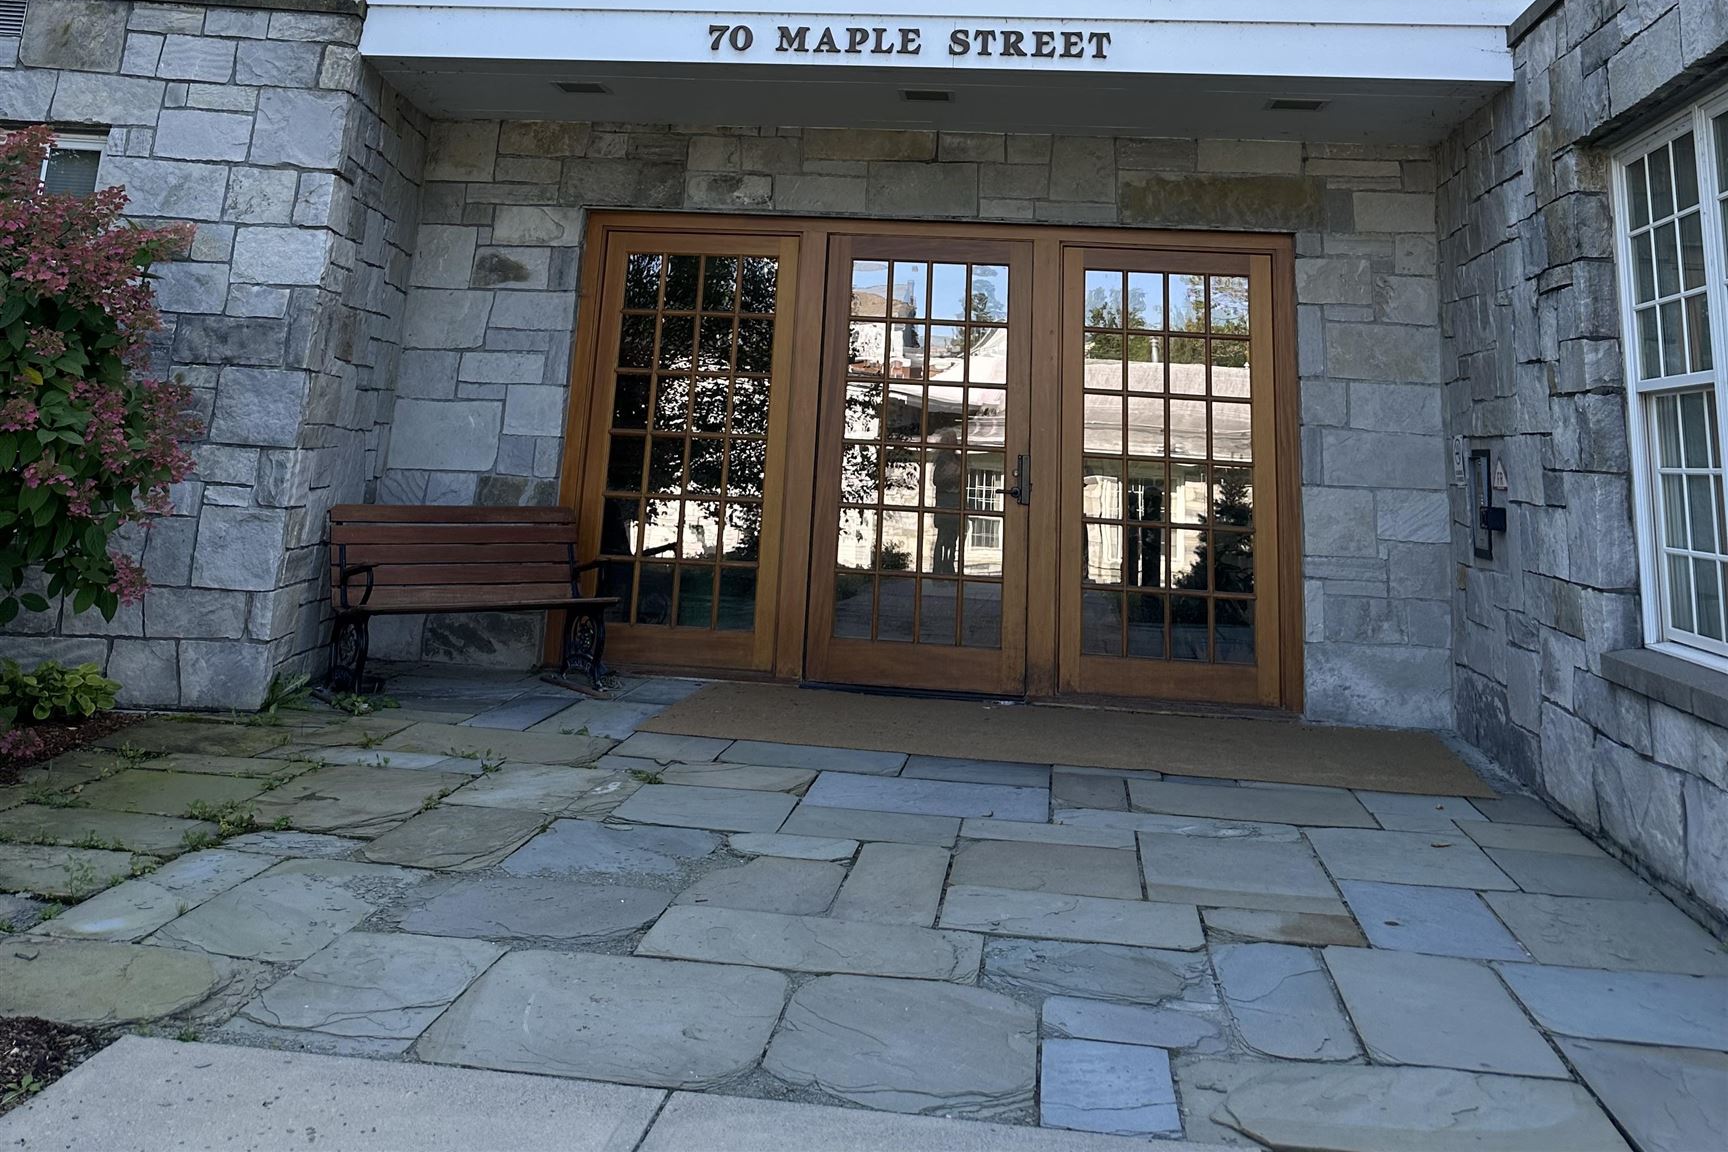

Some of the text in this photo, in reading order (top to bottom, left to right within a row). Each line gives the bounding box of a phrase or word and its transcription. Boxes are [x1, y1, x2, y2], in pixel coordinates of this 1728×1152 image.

[708, 24, 1112, 59] 70 MAPLE STREET
